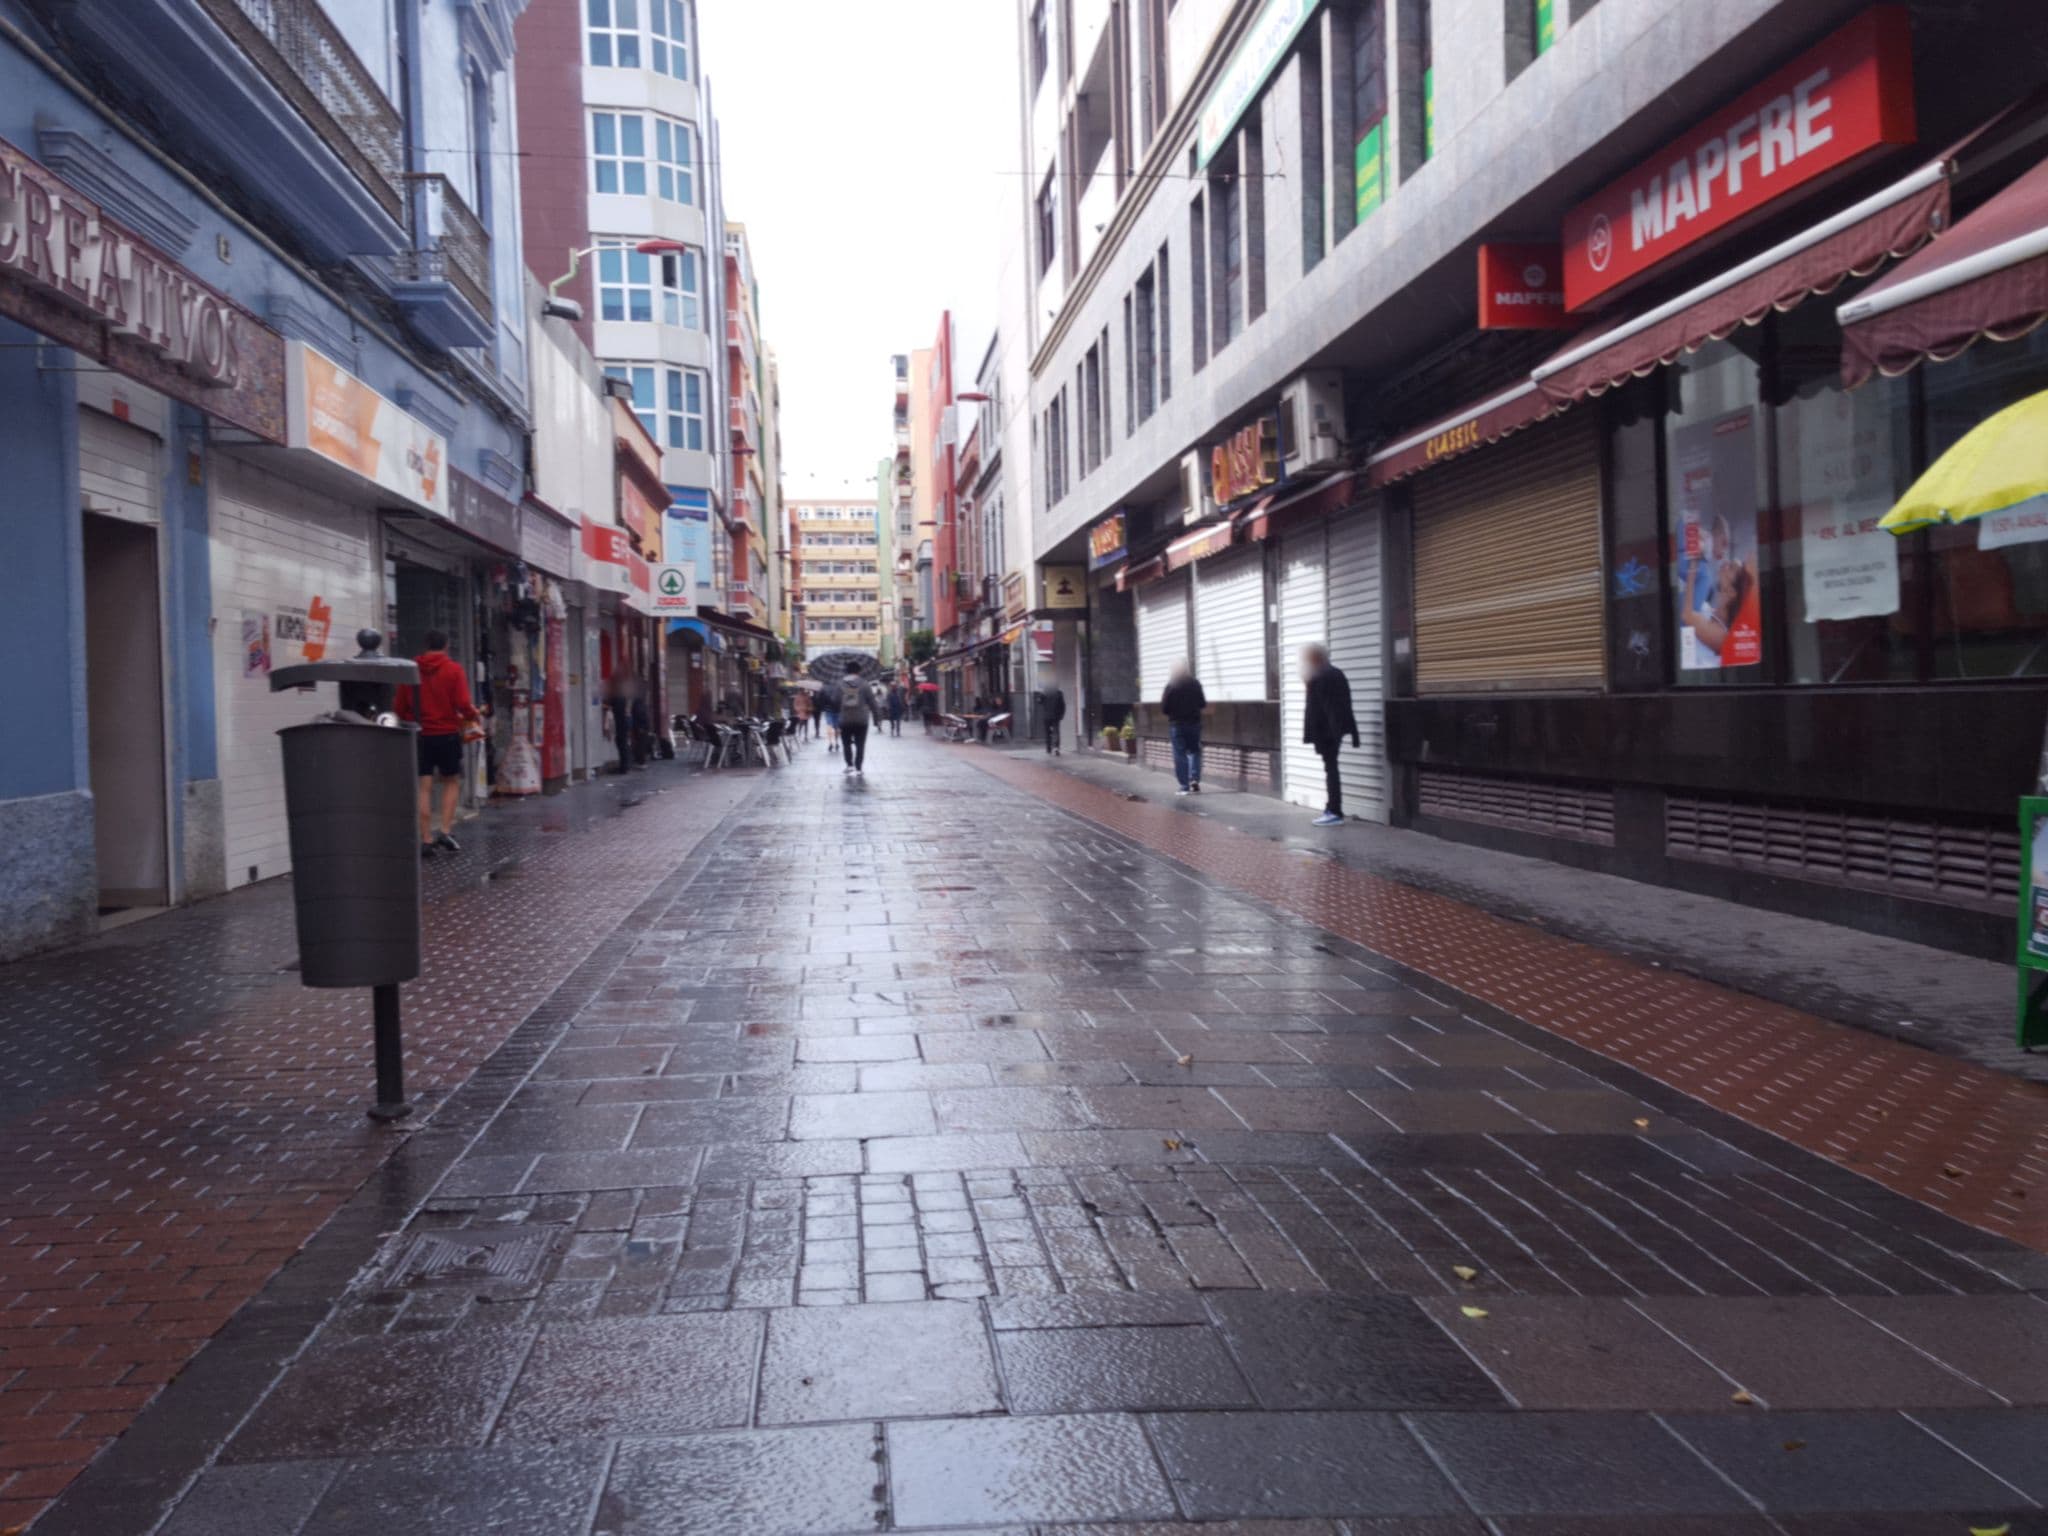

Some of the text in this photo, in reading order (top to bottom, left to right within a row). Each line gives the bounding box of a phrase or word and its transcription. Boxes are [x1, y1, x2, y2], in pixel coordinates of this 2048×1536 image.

[1631, 67, 1833, 252] MAPFRE
[1495, 292, 1563, 305] MAPFR
[1426, 420, 1478, 460] CLASSIC
